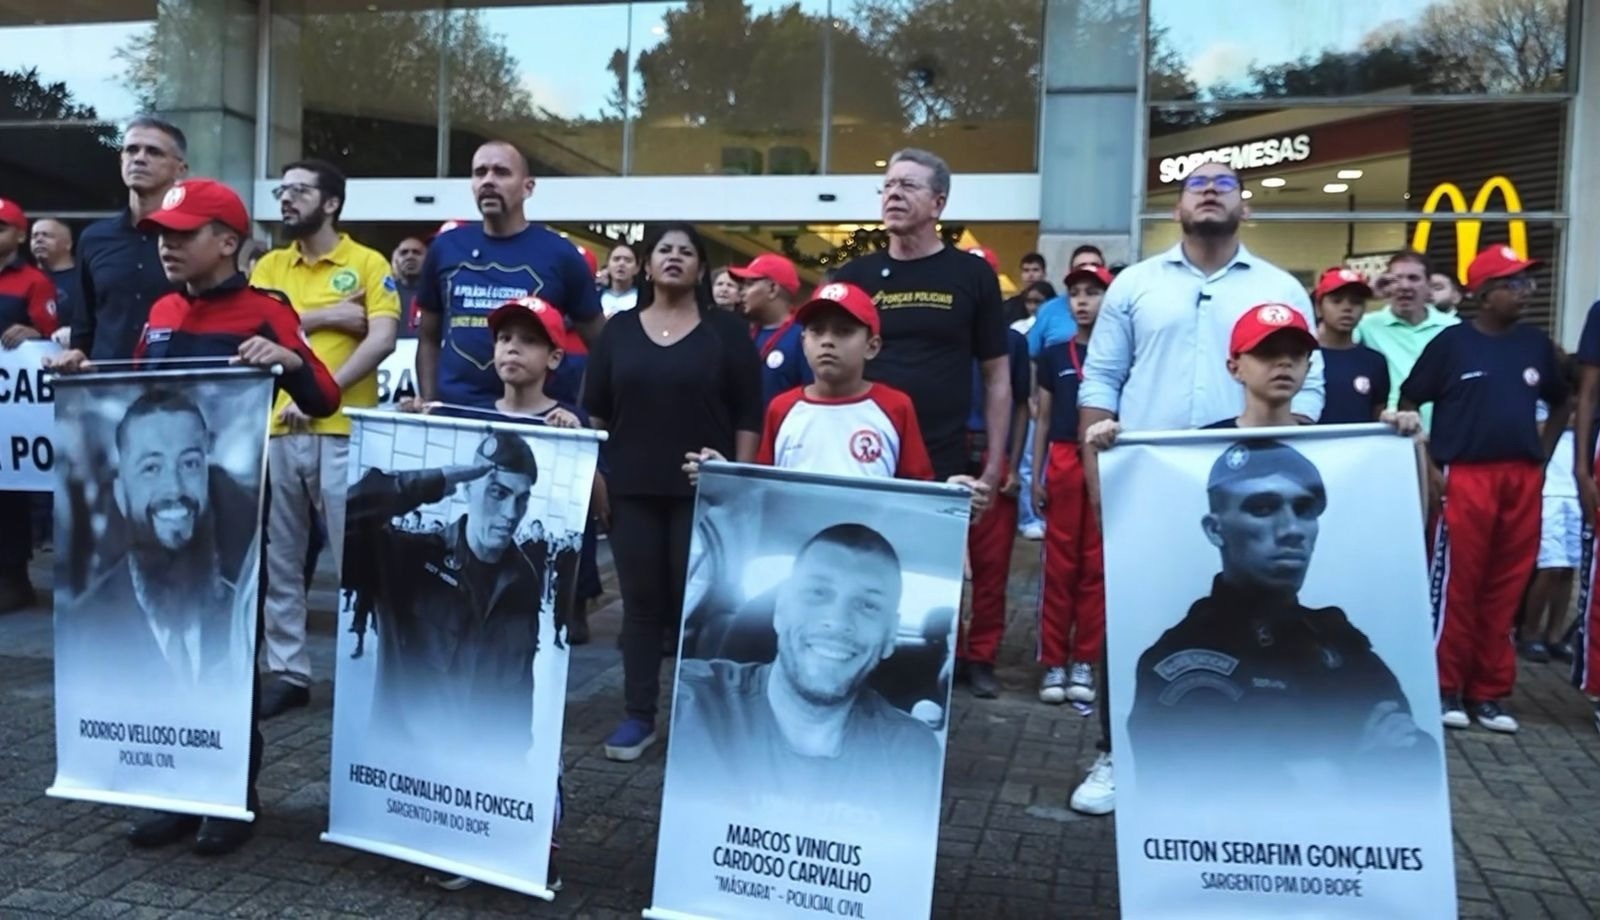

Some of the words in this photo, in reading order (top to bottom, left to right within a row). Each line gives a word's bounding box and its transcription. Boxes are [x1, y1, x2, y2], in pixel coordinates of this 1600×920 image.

[80, 719, 126, 742] RODRIGO
[128, 724, 177, 746] VELLOSO
[179, 728, 223, 750] CABRAL
[119, 750, 154, 767] POLICIAL
[156, 753, 176, 769] CIVIL
[350, 763, 387, 789] HEBER
[389, 773, 452, 805] CARVALHO
[455, 788, 473, 810] DA
[475, 792, 535, 823] FONSECA
[386, 798, 432, 824] SARGENTO
[433, 810, 449, 827] PM
[450, 814, 465, 831] DO
[466, 817, 491, 837] BOPE
[726, 824, 791, 854] MARCOS
[796, 835, 862, 866] VINICIUS
[1143, 838, 1217, 862] CLEITON
[1222, 841, 1301, 867] SERAFIM
[1307, 844, 1424, 875] GONÇALVES
[713, 846, 785, 878] CARDOSO
[788, 860, 872, 894] CARVALHO
[1201, 872, 1272, 893] SARGENTO
[1275, 875, 1298, 893] PM
[1301, 877, 1322, 895] DO
[1325, 878, 1363, 897] BOPE
[786, 889, 836, 914] POLICIAL
[837, 899, 865, 919] CIVIL
